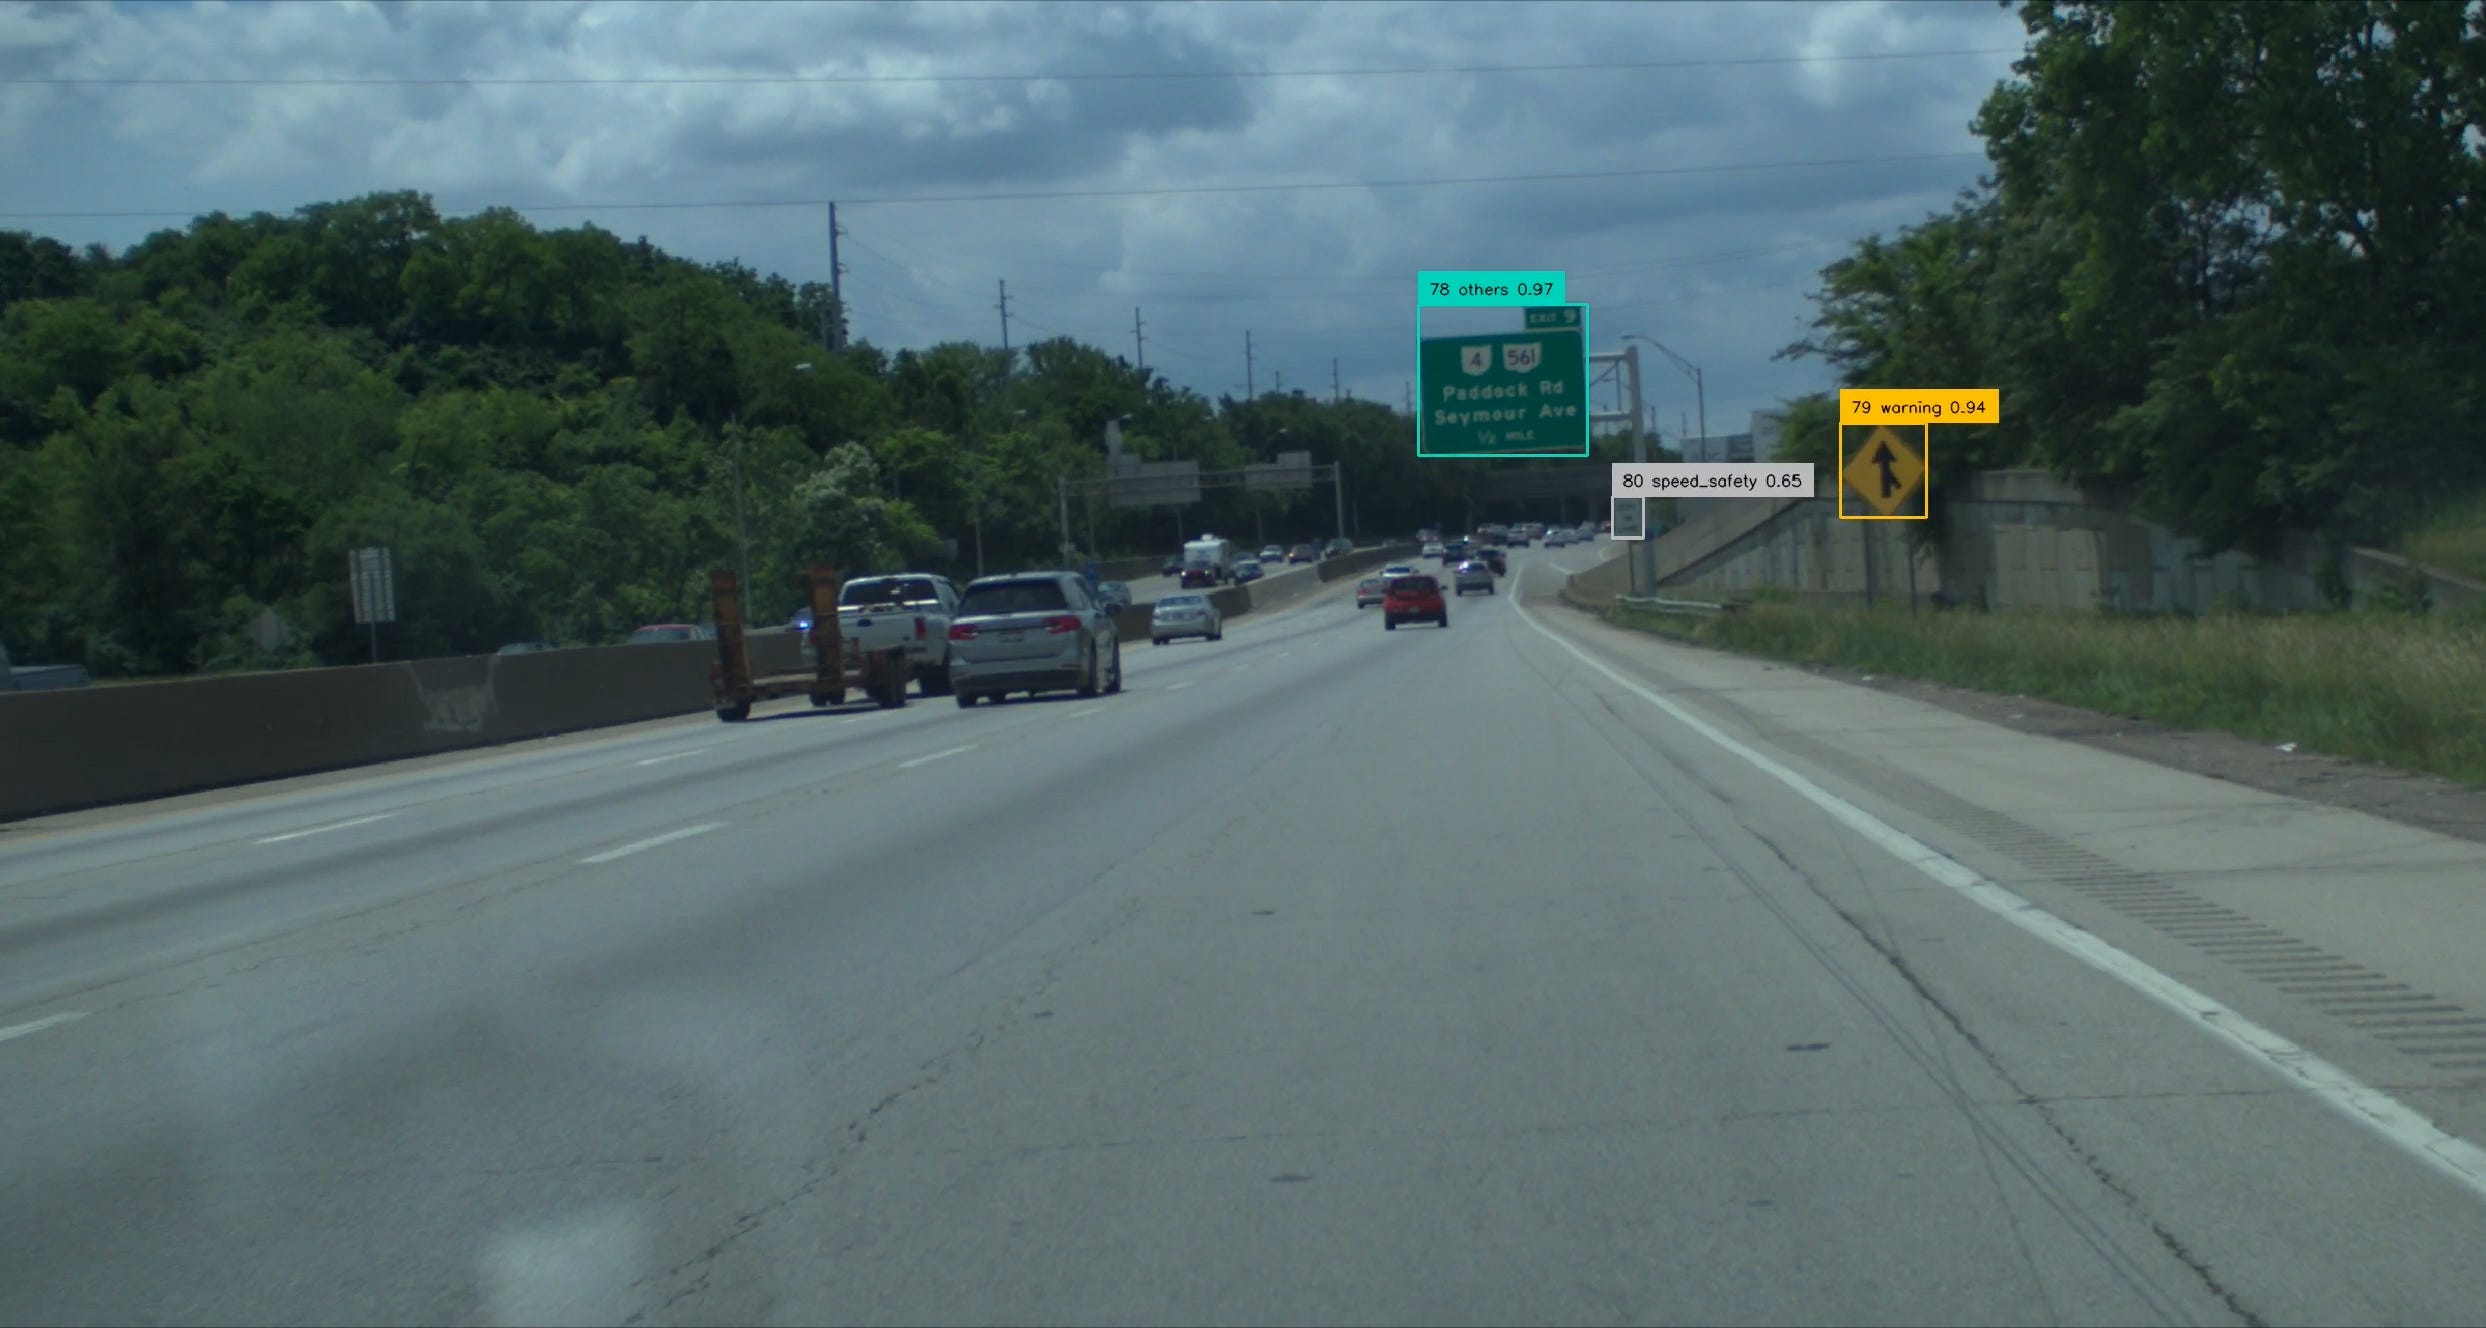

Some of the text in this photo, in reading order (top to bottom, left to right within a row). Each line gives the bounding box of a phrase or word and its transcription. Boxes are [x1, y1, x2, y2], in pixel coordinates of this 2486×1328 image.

[1529, 309, 1577, 323] EXIT 9
[1470, 352, 1482, 367] 4
[1507, 348, 1536, 366] 561
[1442, 380, 1564, 401] Paddock Rd
[1434, 404, 1577, 427] Seymour Ave
[1505, 430, 1535, 441] MILE
